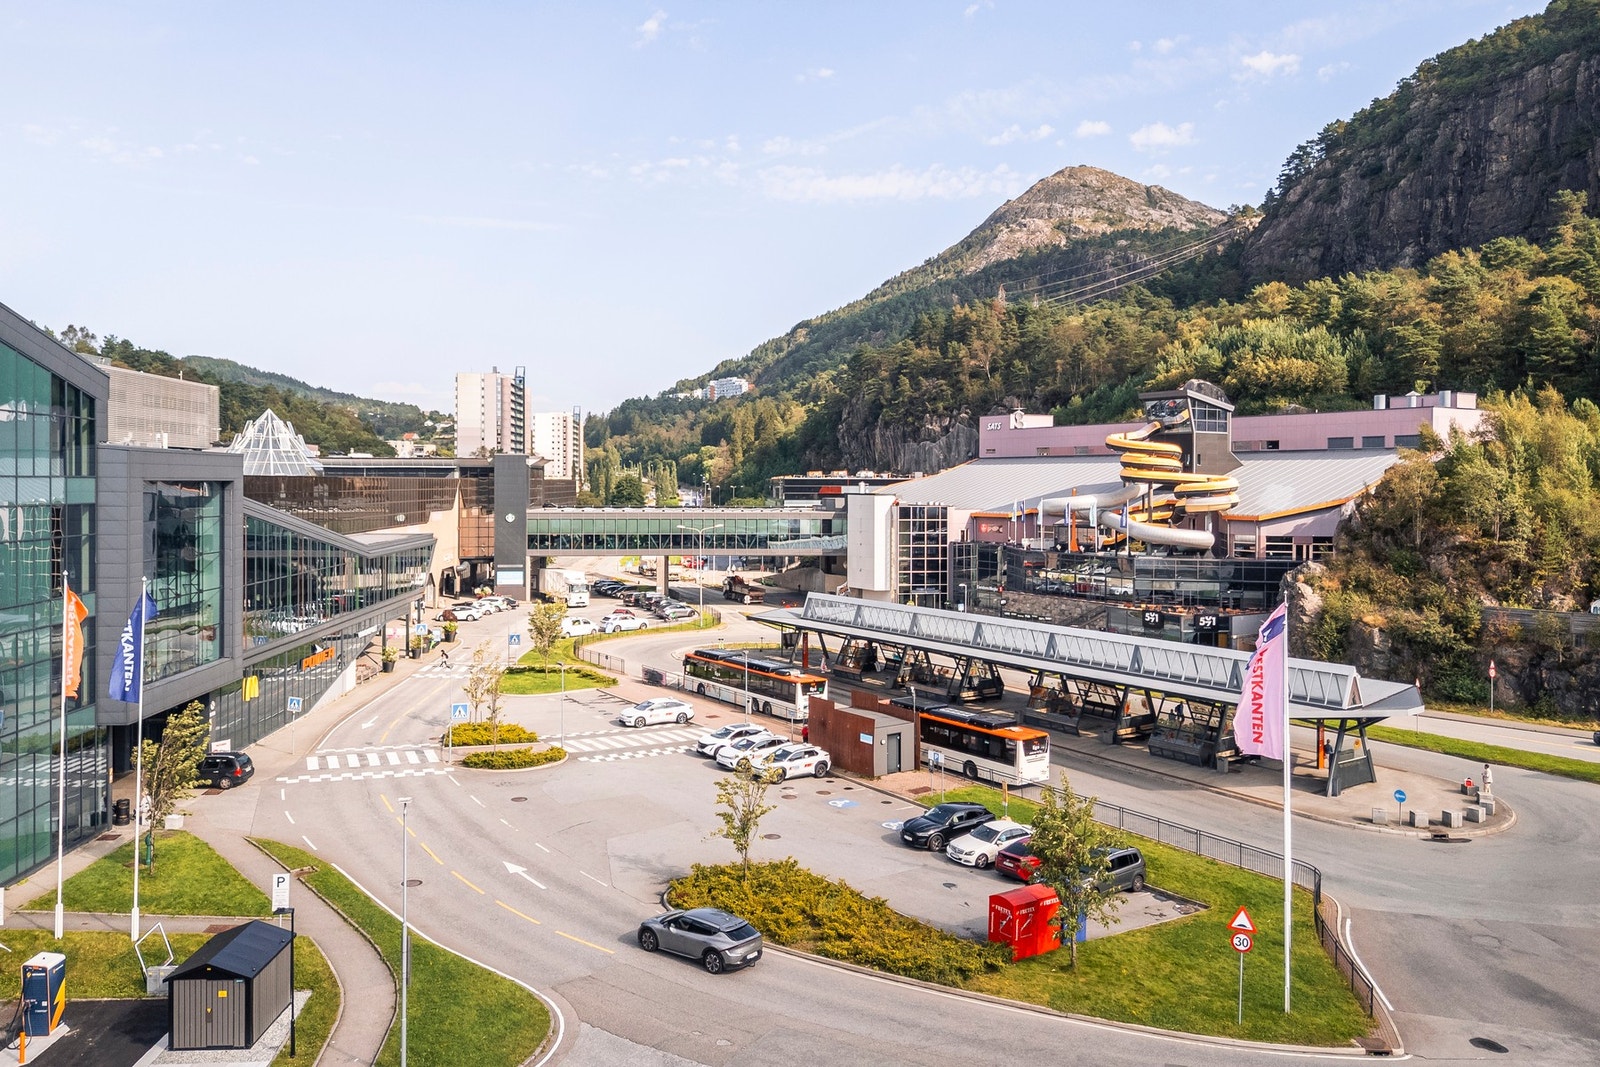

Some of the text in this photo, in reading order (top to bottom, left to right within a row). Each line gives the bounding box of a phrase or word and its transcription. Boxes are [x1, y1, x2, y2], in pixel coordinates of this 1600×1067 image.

[987, 422, 1001, 430] SATS
[277, 877, 285, 887] P
[1235, 937, 1248, 947] 30
